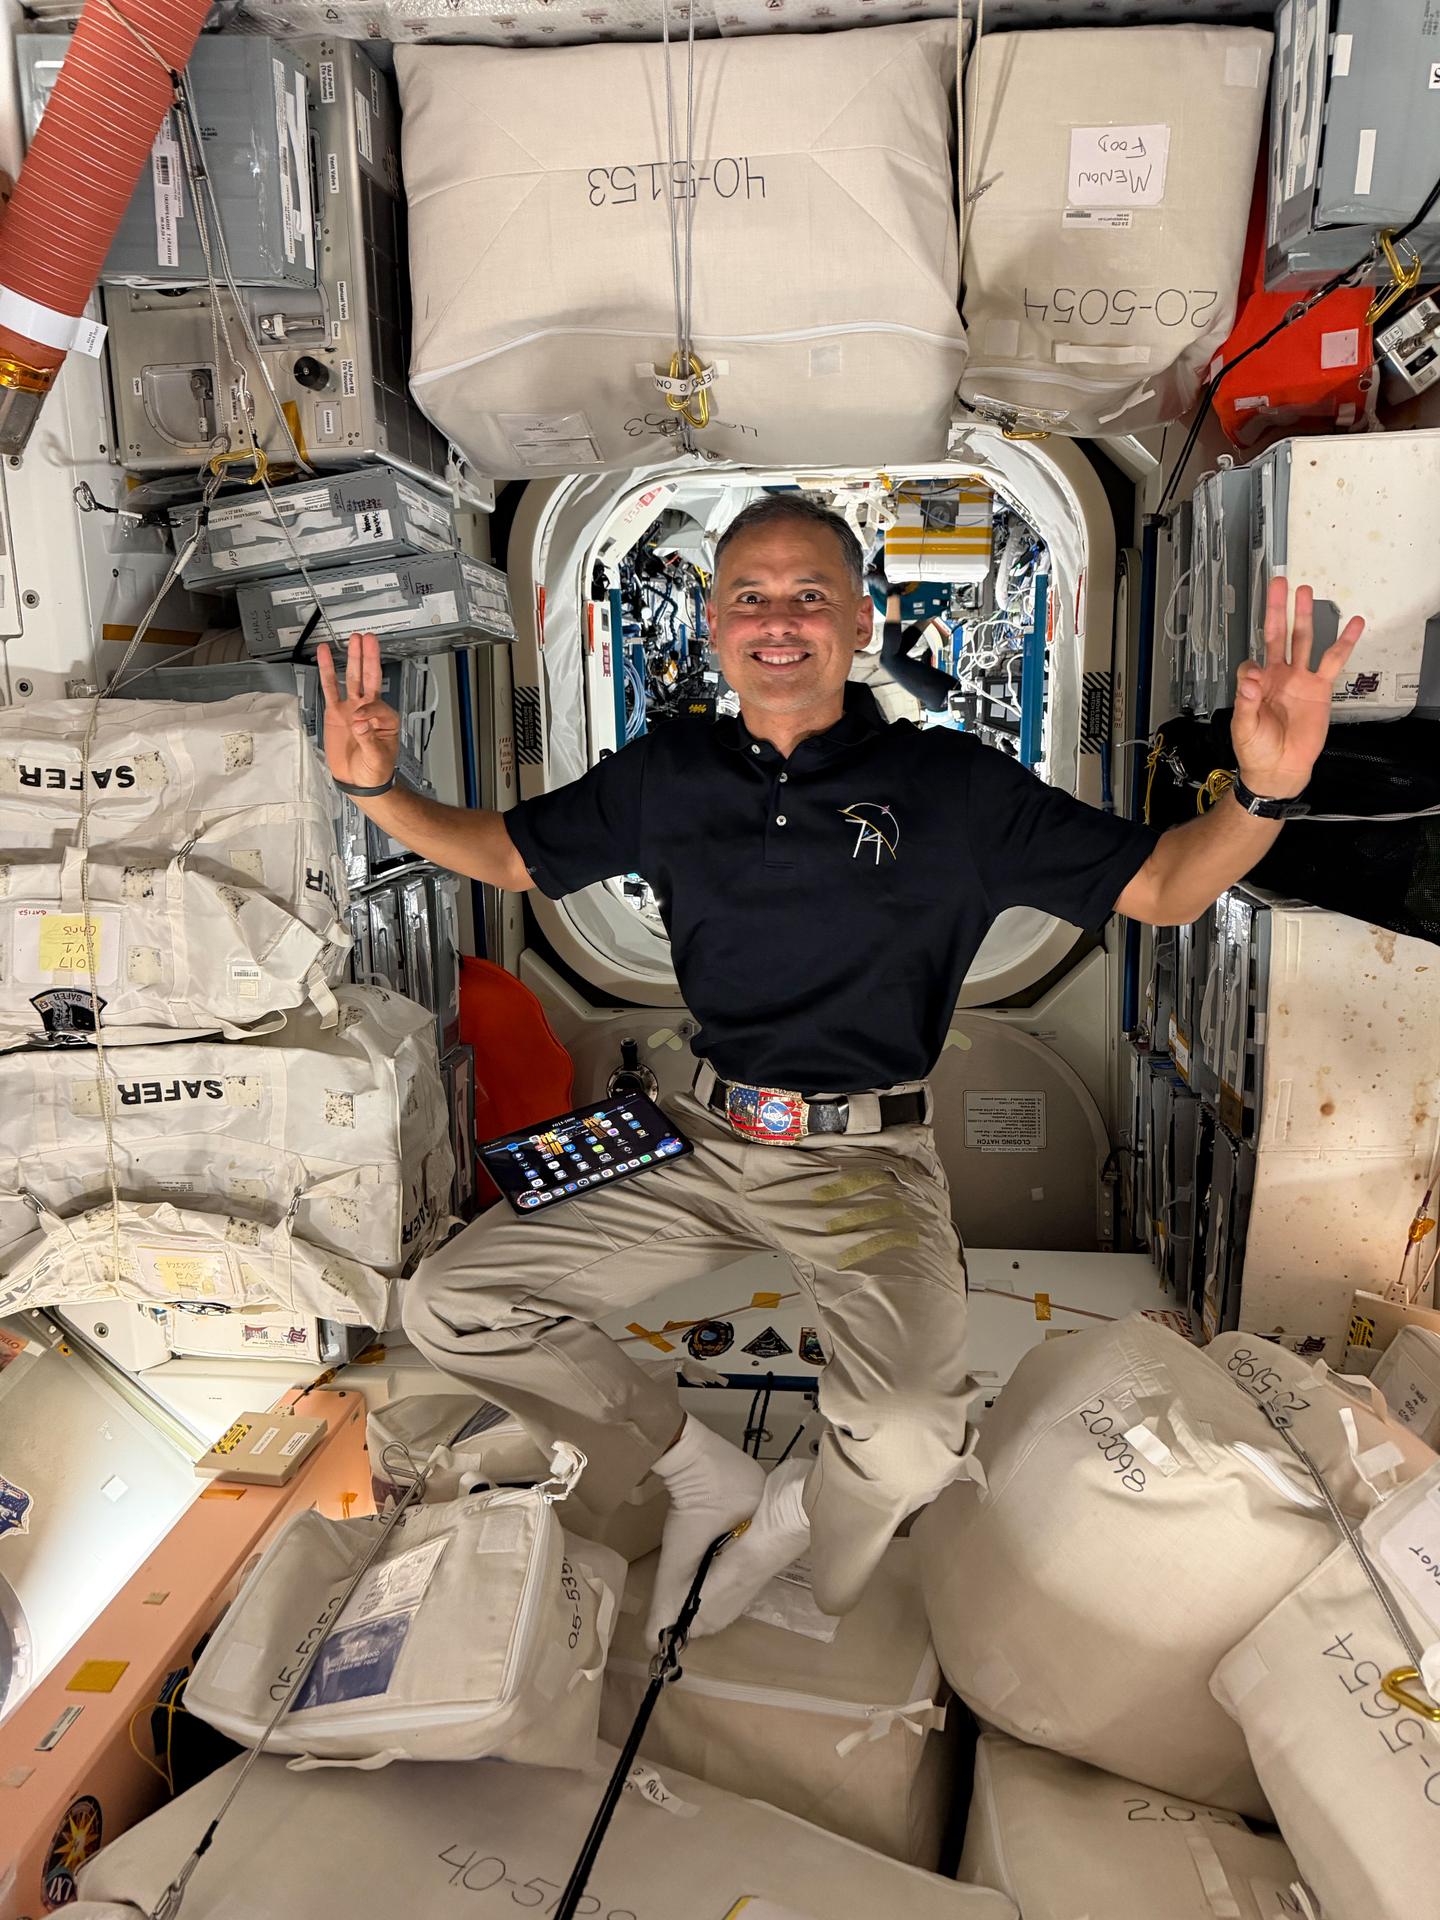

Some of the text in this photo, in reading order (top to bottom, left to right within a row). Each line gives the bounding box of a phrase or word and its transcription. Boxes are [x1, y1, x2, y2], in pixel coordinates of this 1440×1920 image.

[1079, 164, 1152, 194] MENON
[19, 765, 136, 790] SAFER
[53, 992, 83, 1002] SAFER
[118, 1079, 224, 1106] SAFER
